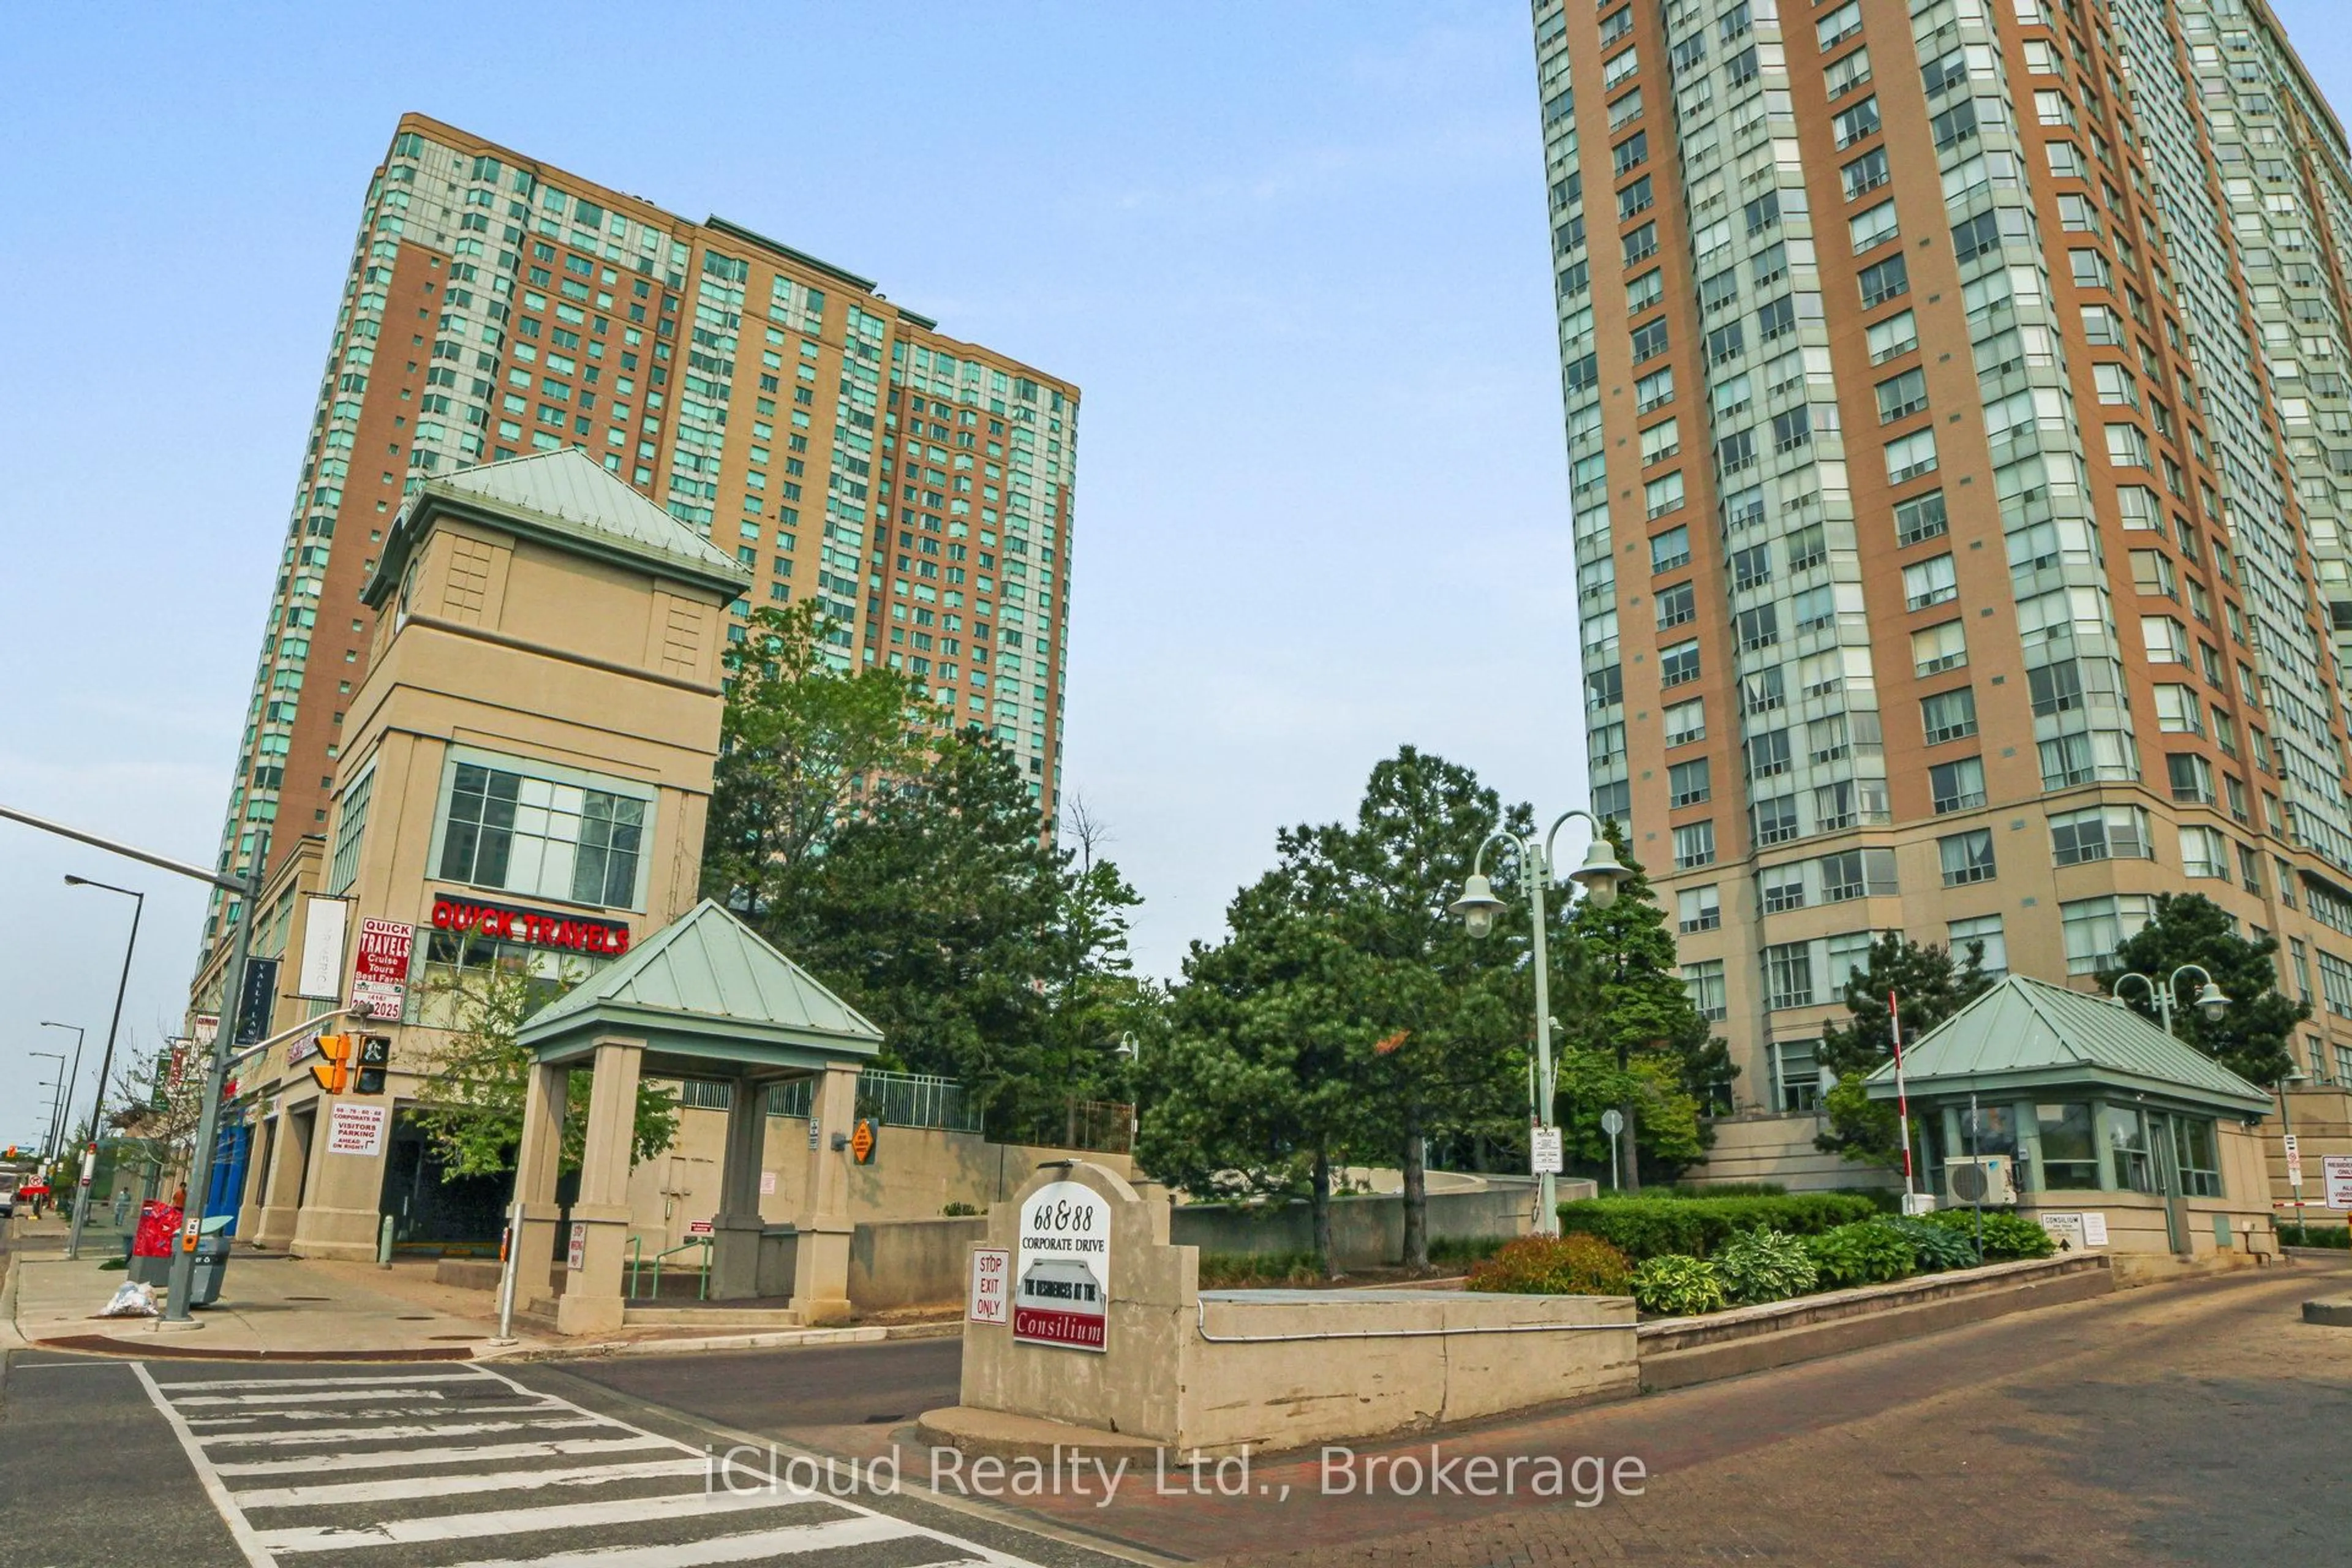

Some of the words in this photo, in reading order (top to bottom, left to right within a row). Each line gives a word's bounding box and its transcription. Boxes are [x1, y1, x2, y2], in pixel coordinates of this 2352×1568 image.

[366, 921, 410, 935] QUICK
[432, 900, 514, 939] QUICK
[522, 913, 629, 955] TRAVELS
[361, 933, 411, 958] TRAVELS
[368, 954, 398, 965] Cruise
[355, 971, 376, 981] Best
[369, 963, 394, 974] Tours
[254, 963, 265, 1005] VALLI
[247, 1011, 257, 1035] LAW
[338, 1122, 376, 1131] VISITORS
[1034, 1205, 1053, 1231] 68
[1072, 1205, 1093, 1231] 88
[1022, 1237, 1072, 1251] CORPORATE
[1076, 1239, 1104, 1253] DRIVE
[980, 1256, 1001, 1272] STOP
[981, 1278, 999, 1294] EXIT
[1025, 1279, 1035, 1295] THE
[1036, 1280, 1072, 1299] RESIDENCES
[1074, 1283, 1082, 1300] AT
[1084, 1284, 1096, 1302] THE
[978, 1298, 1000, 1316] ONLY
[1017, 1311, 1101, 1341] Consilium
